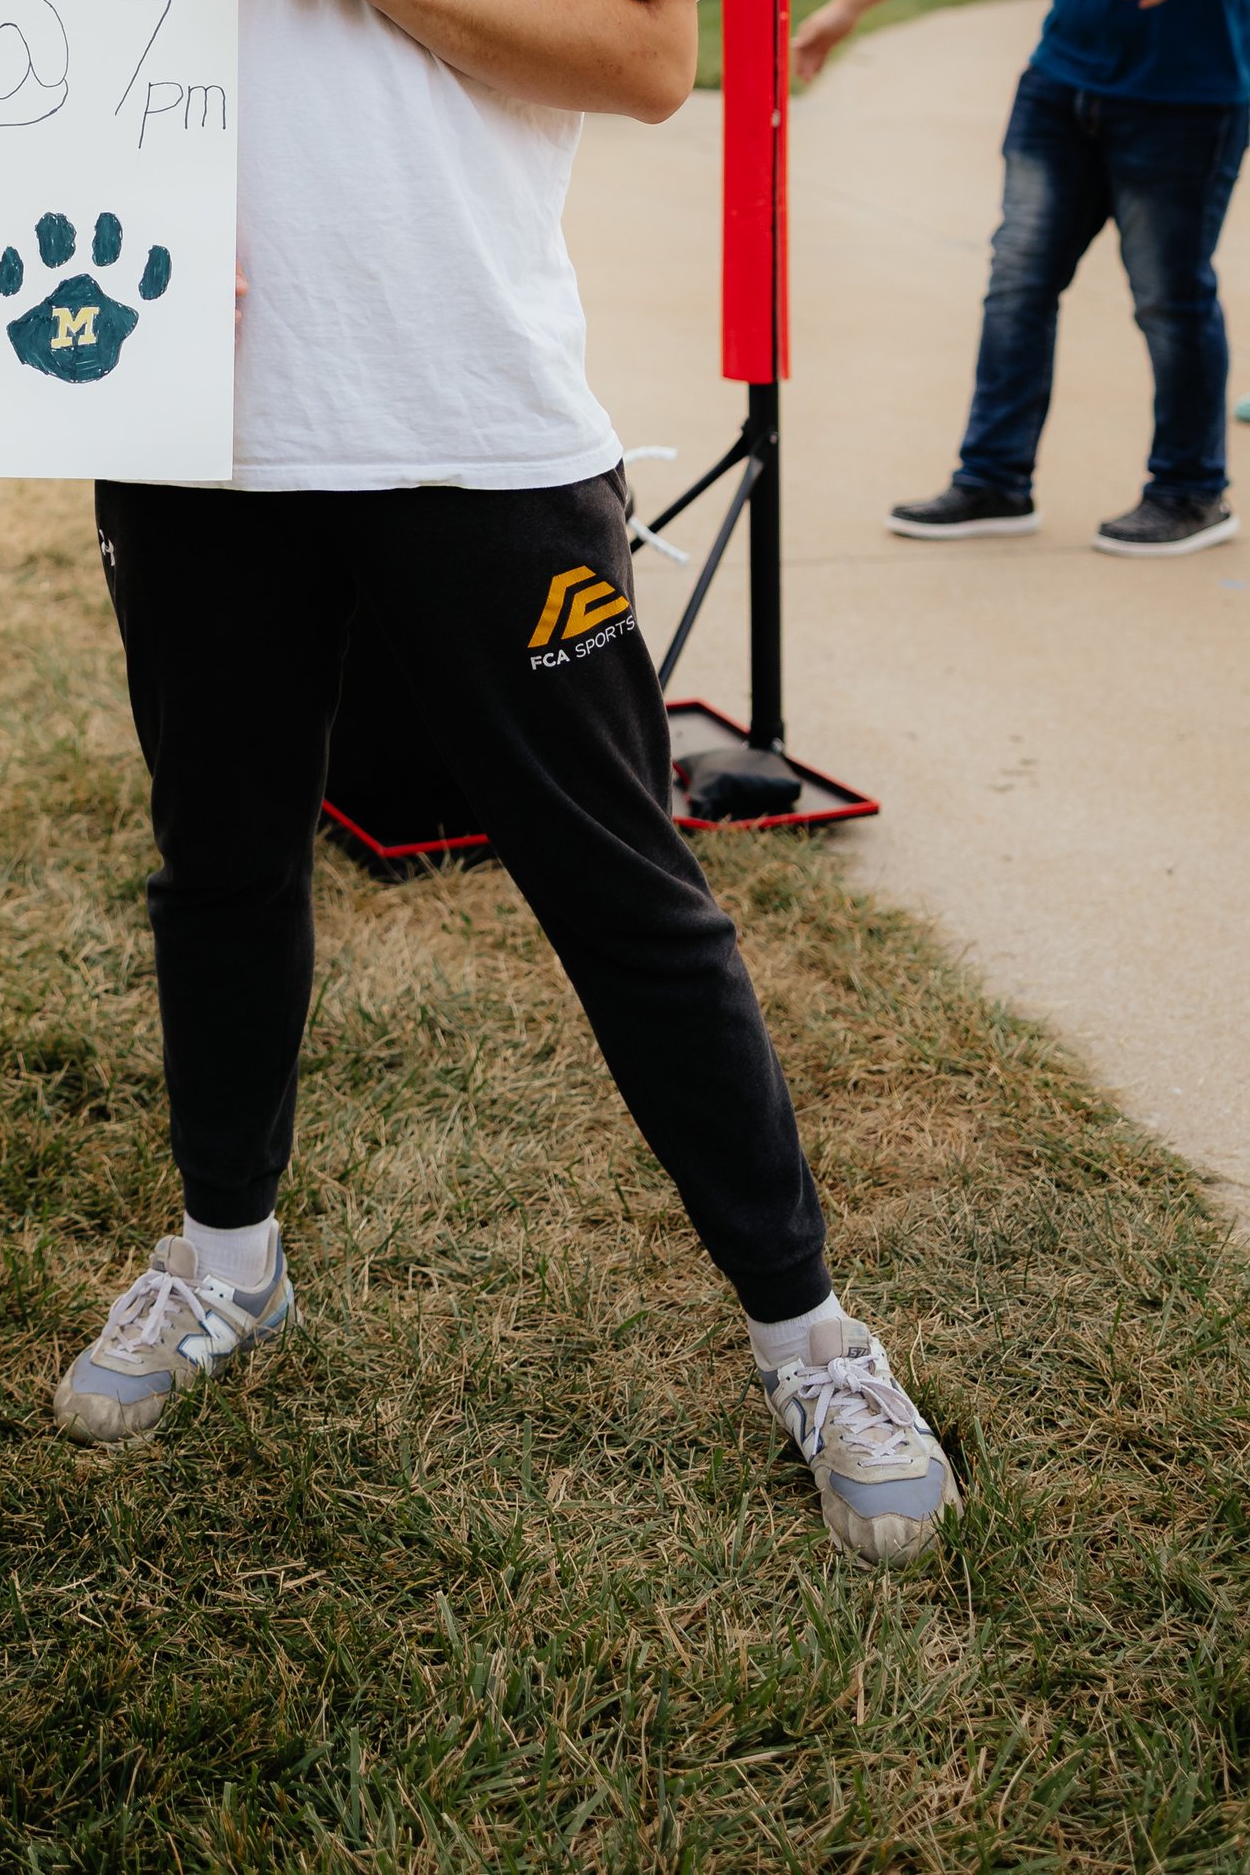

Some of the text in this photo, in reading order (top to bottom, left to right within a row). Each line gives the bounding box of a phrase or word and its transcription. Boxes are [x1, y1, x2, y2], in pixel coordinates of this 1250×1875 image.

[50, 305, 101, 350] M
[529, 614, 636, 671] FCA SPORTS
